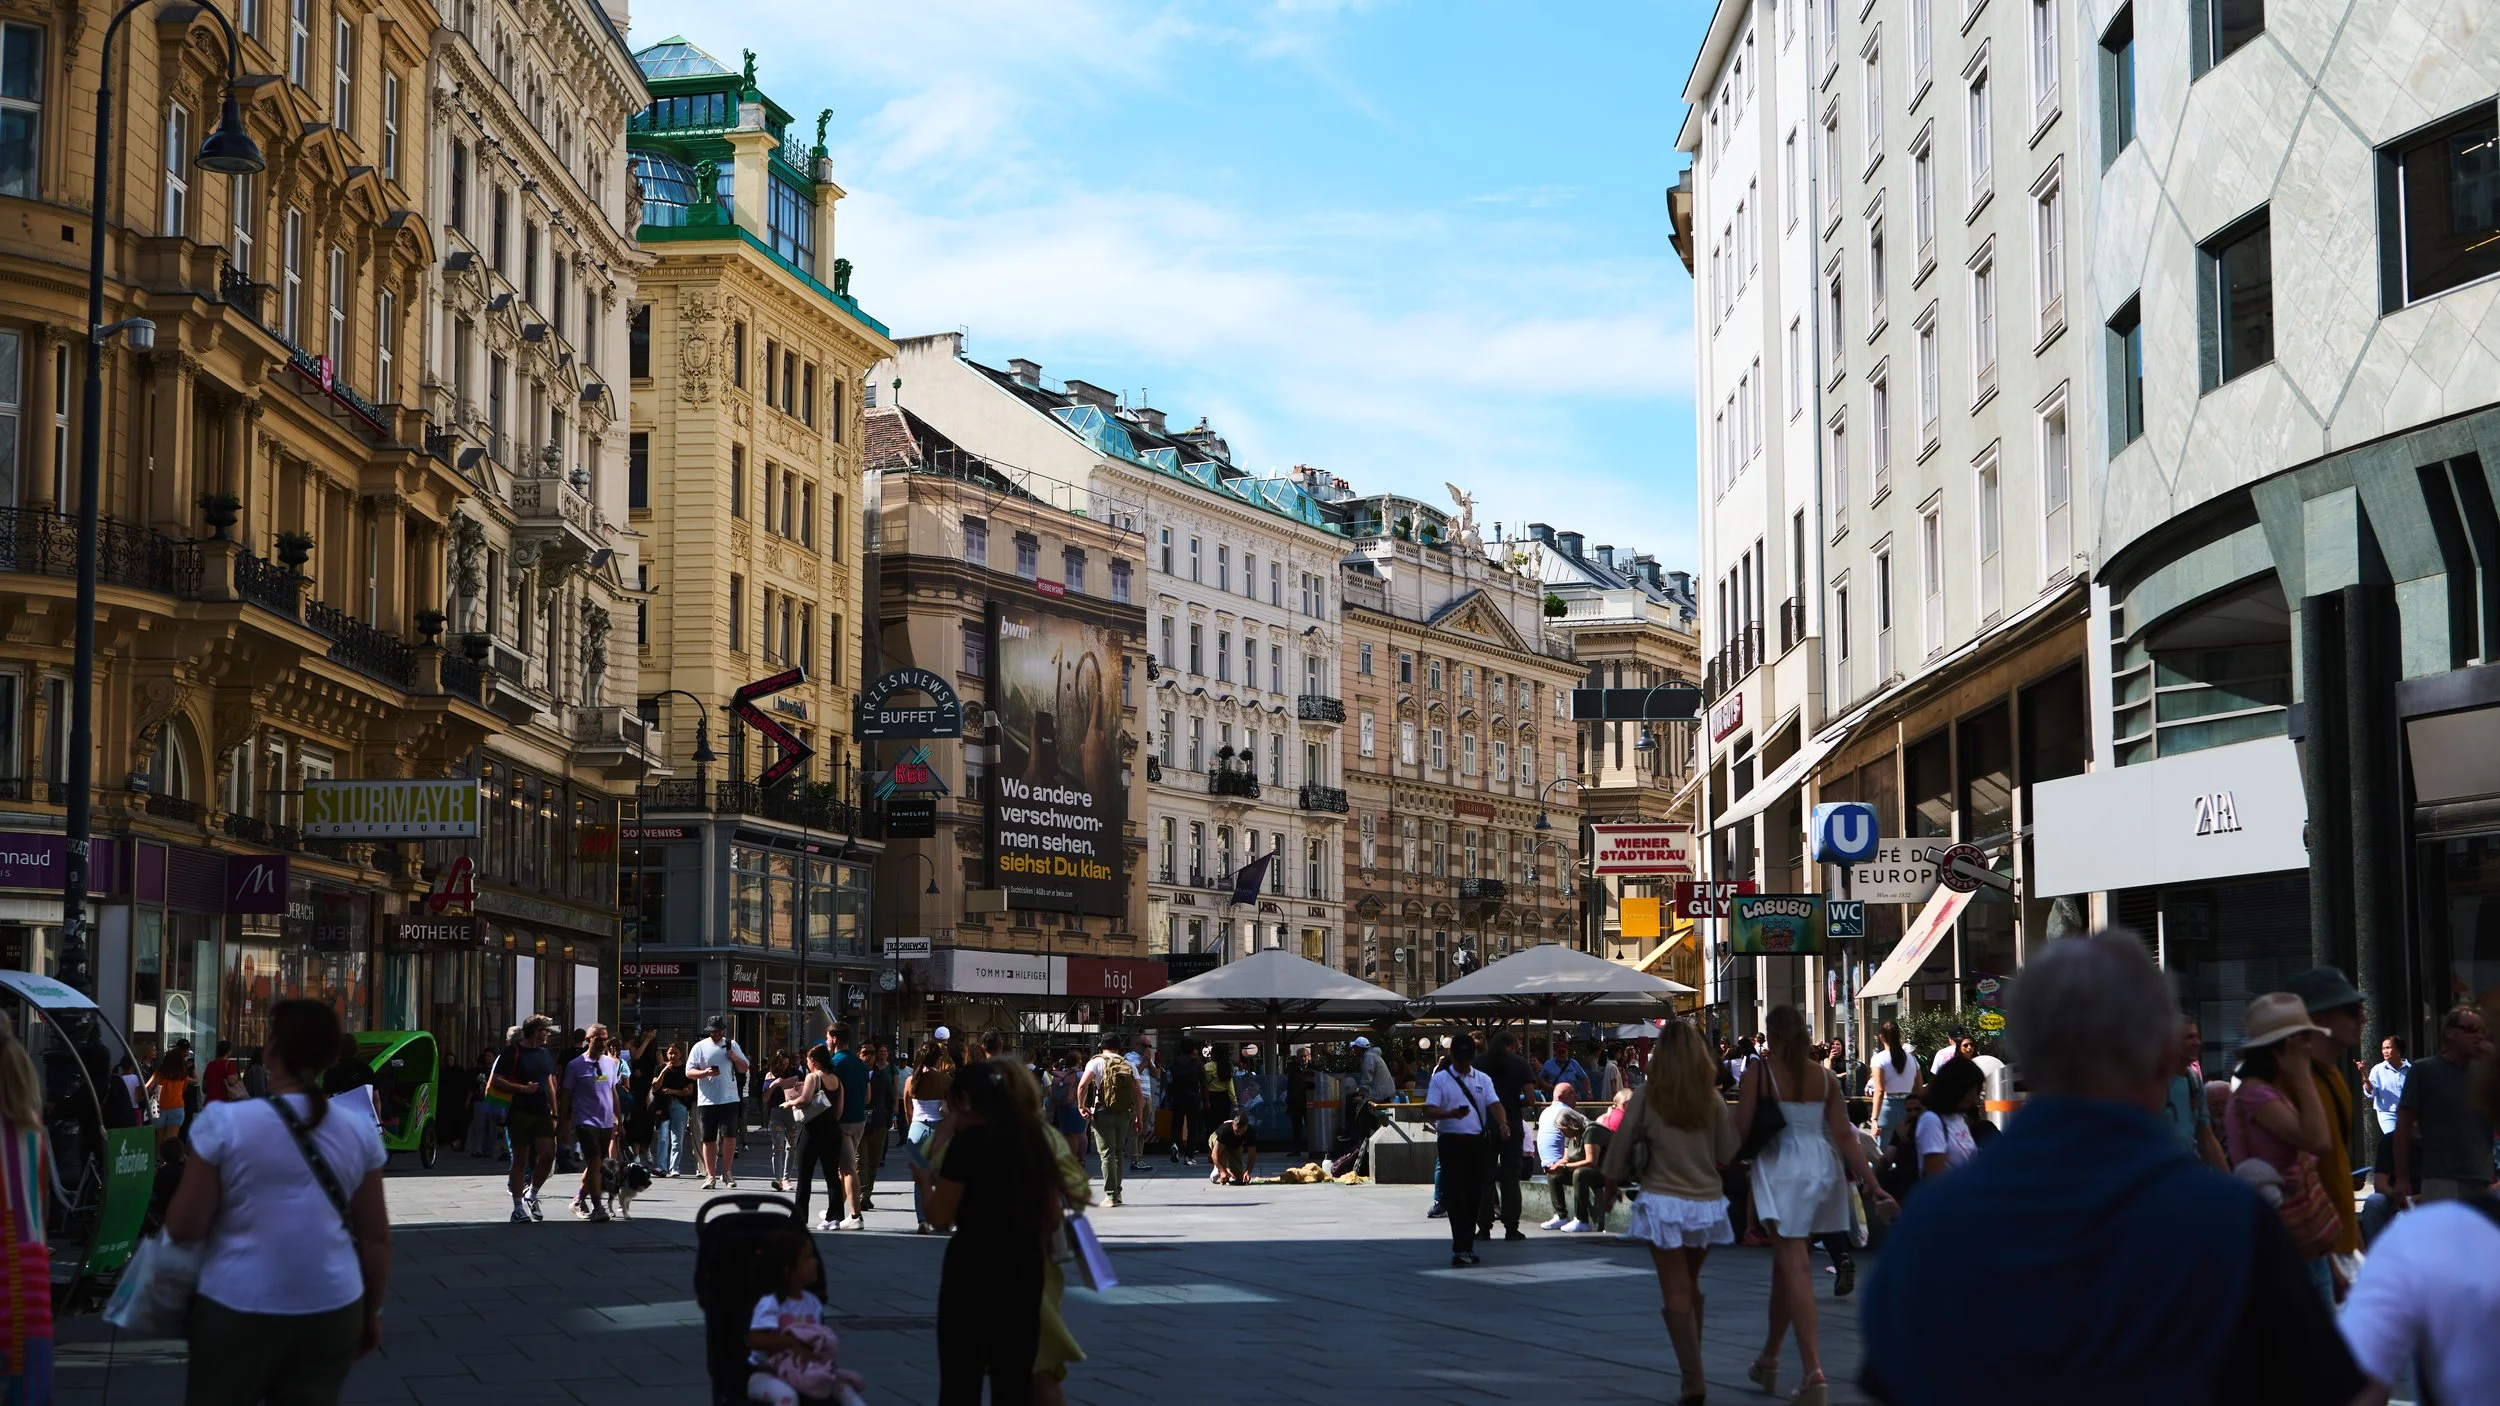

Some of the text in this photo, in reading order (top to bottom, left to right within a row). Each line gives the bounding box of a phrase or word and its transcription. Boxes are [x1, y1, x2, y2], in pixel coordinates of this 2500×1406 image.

[1000, 615, 1030, 640] bwin
[880, 710, 936, 723] BUFFET
[740, 706, 800, 755] FLEDERMAUS
[1000, 776, 1092, 808] Wo andere
[315, 784, 465, 823] STURMAYR
[1000, 806, 1103, 832] verschwom-
[2194, 791, 2242, 836] ZARA
[315, 824, 464, 833] COIFFEURE
[1832, 814, 1869, 853] U
[1000, 831, 1096, 857] men sehen,
[1614, 838, 1671, 848] WIENER
[1599, 849, 1686, 861] STADTBRÄU
[1000, 851, 1111, 881] siehst Du klar.
[1174, 893, 1196, 906] LISKA
[1693, 884, 1738, 899] FIVE
[1308, 906, 1326, 918] LISKA
[1742, 900, 1812, 919] LABUBU
[1830, 903, 1861, 920] WC
[399, 924, 470, 940] APOTHEKE
[975, 968, 1047, 980] TOMMY HILFIGER
[731, 990, 760, 1004] SOUVENIRS
[771, 993, 786, 1006] GIFTS
